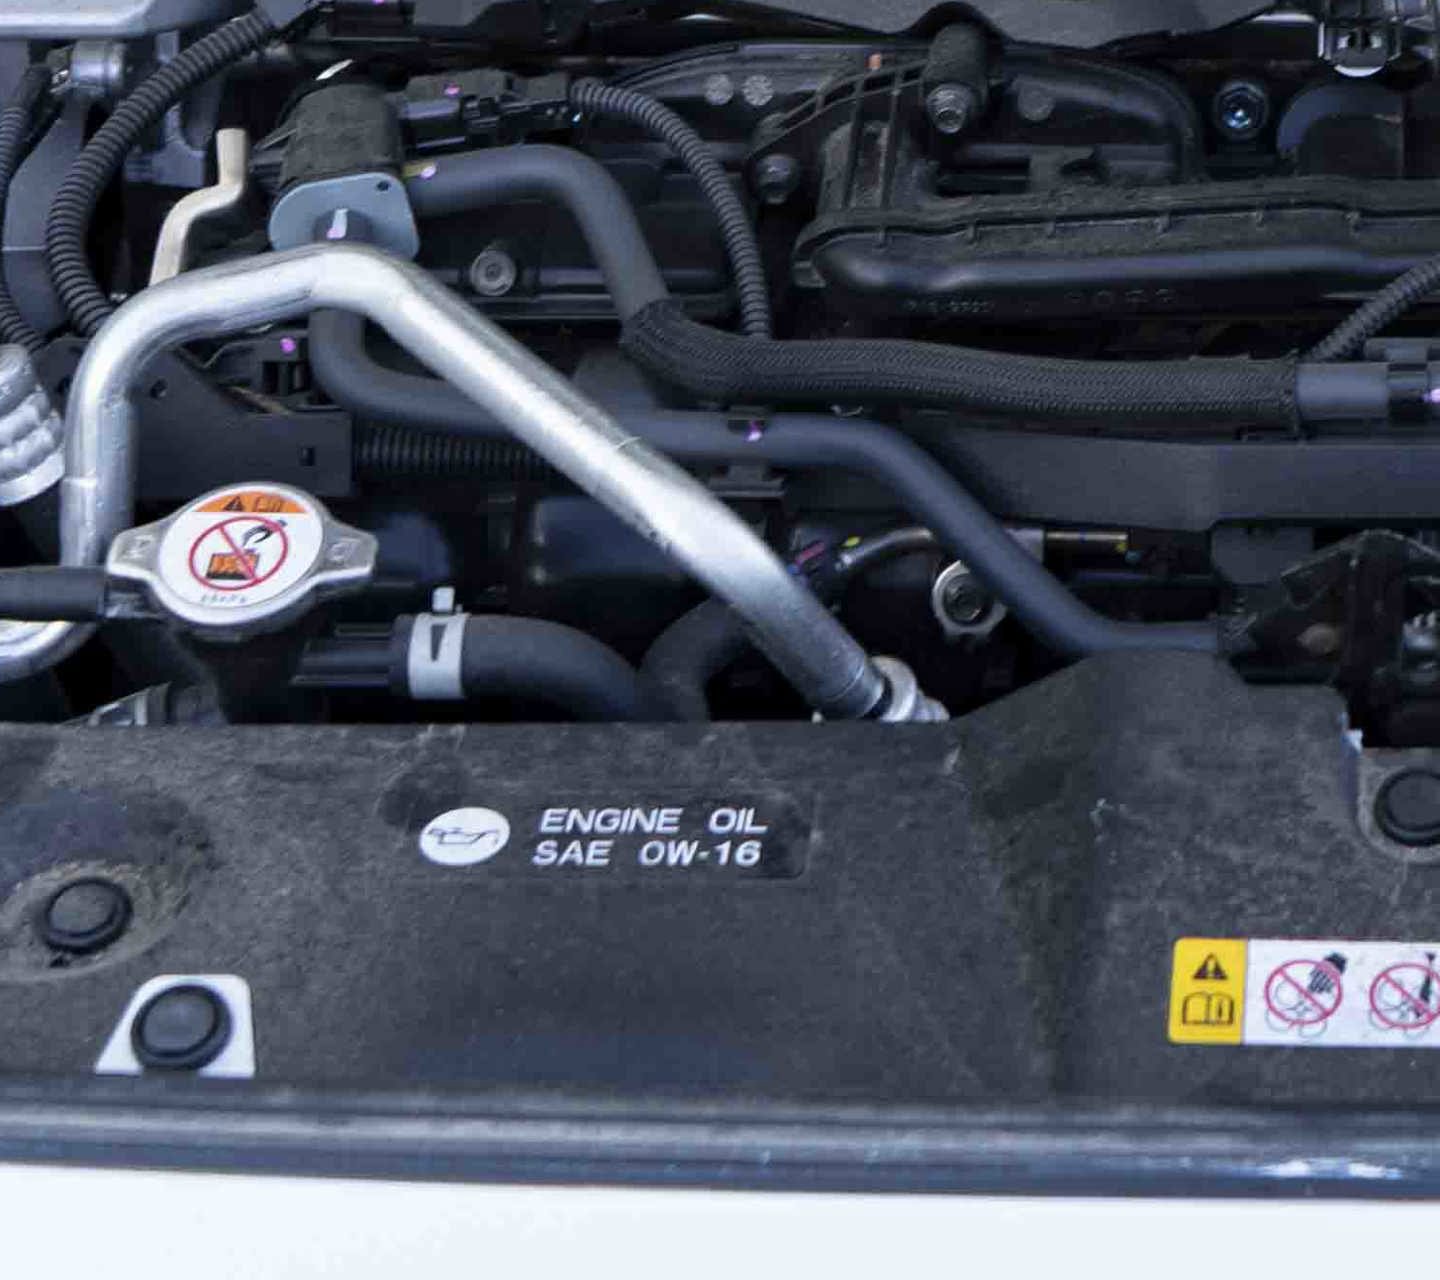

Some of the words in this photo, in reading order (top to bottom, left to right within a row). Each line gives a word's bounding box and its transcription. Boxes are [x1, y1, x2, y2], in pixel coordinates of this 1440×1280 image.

[539, 808, 684, 834] ENGINE
[708, 808, 769, 834] OIL
[532, 840, 613, 867] SAE
[639, 840, 762, 868] 0W-16
